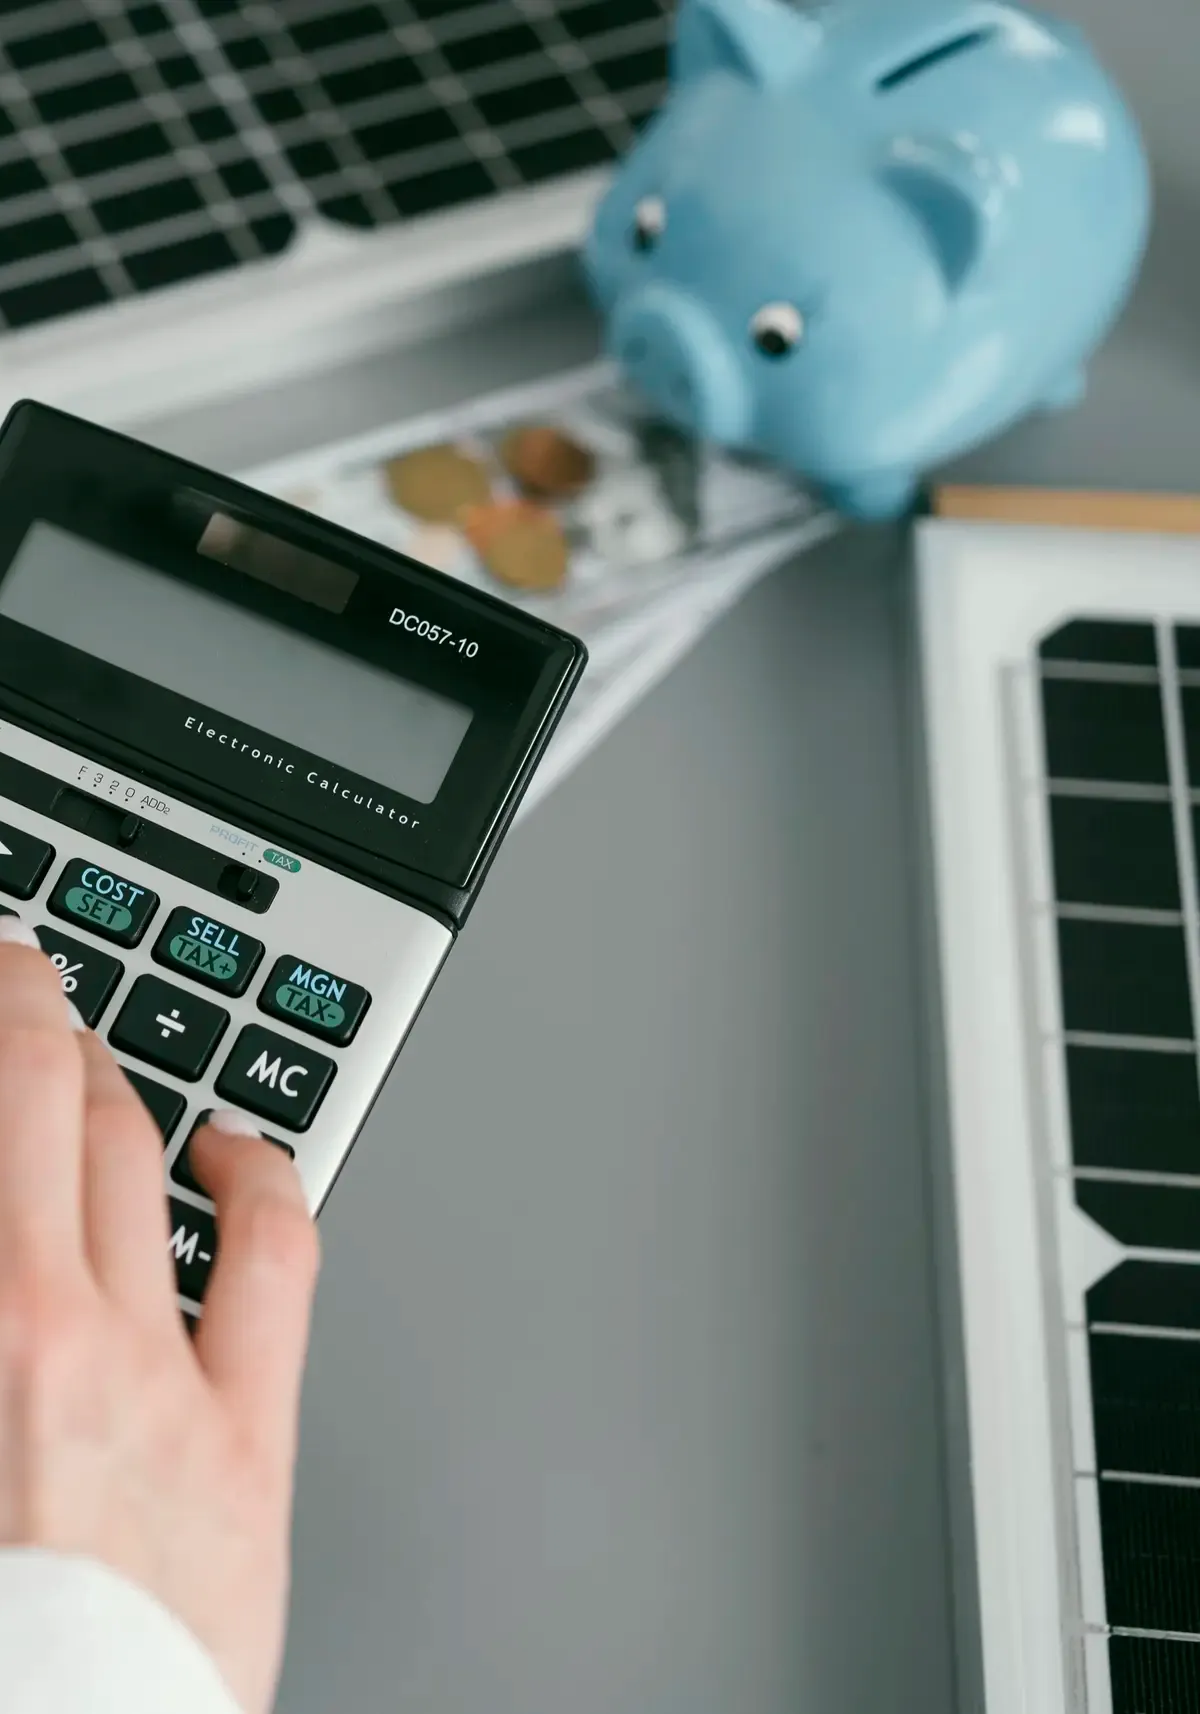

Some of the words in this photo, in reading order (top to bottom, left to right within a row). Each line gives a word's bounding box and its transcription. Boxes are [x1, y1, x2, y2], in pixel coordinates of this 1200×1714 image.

[388, 607, 480, 659] DC057-10
[78, 765, 89, 777] F
[93, 772, 104, 784] 3
[108, 779, 120, 791] 2
[125, 786, 136, 799] 0
[184, 716, 296, 775] Electronic
[306, 771, 422, 830] Calculator
[208, 823, 259, 854] PROFIT
[269, 852, 295, 870] TAX
[80, 867, 145, 907] COST
[77, 892, 123, 926] SET
[175, 937, 232, 975] TAX+
[187, 916, 240, 957] SELL
[288, 964, 347, 1002] MGN
[285, 986, 337, 1023] TAX-
[246, 1050, 308, 1098] MC
